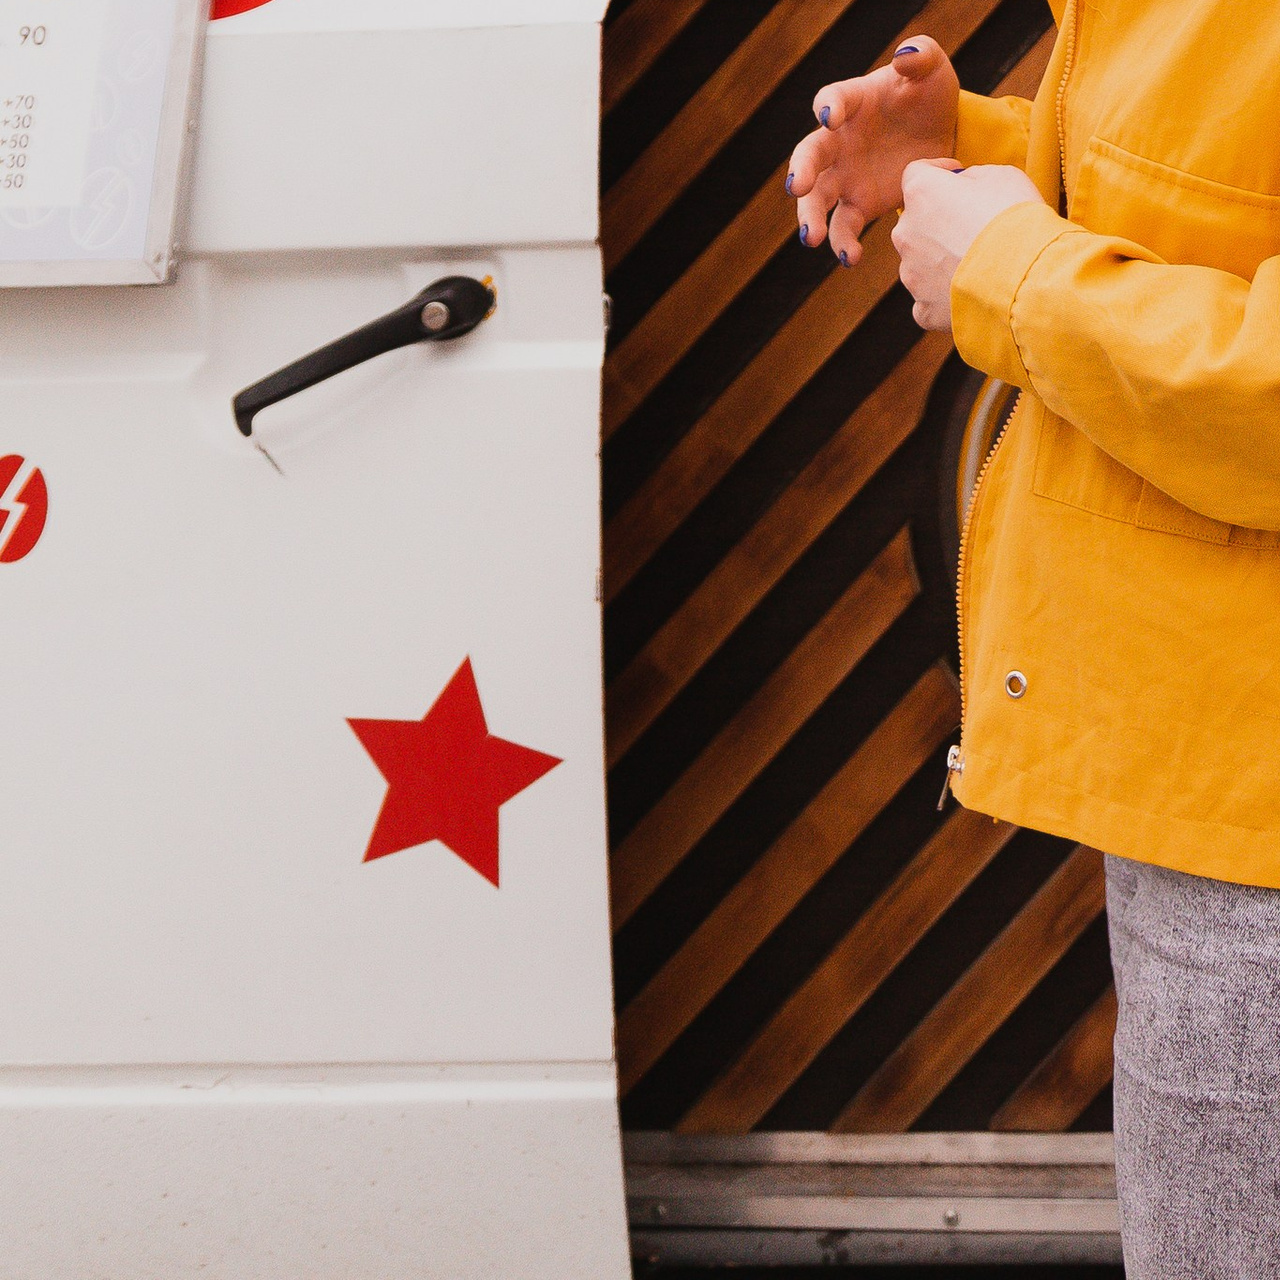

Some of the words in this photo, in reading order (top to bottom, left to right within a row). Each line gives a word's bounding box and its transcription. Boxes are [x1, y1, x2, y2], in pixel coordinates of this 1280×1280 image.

[20, 26, 46, 45] 90
[4, 95, 34, 110] +70
[2, 114, 32, 129] +30
[0, 173, 24, 189] 50
